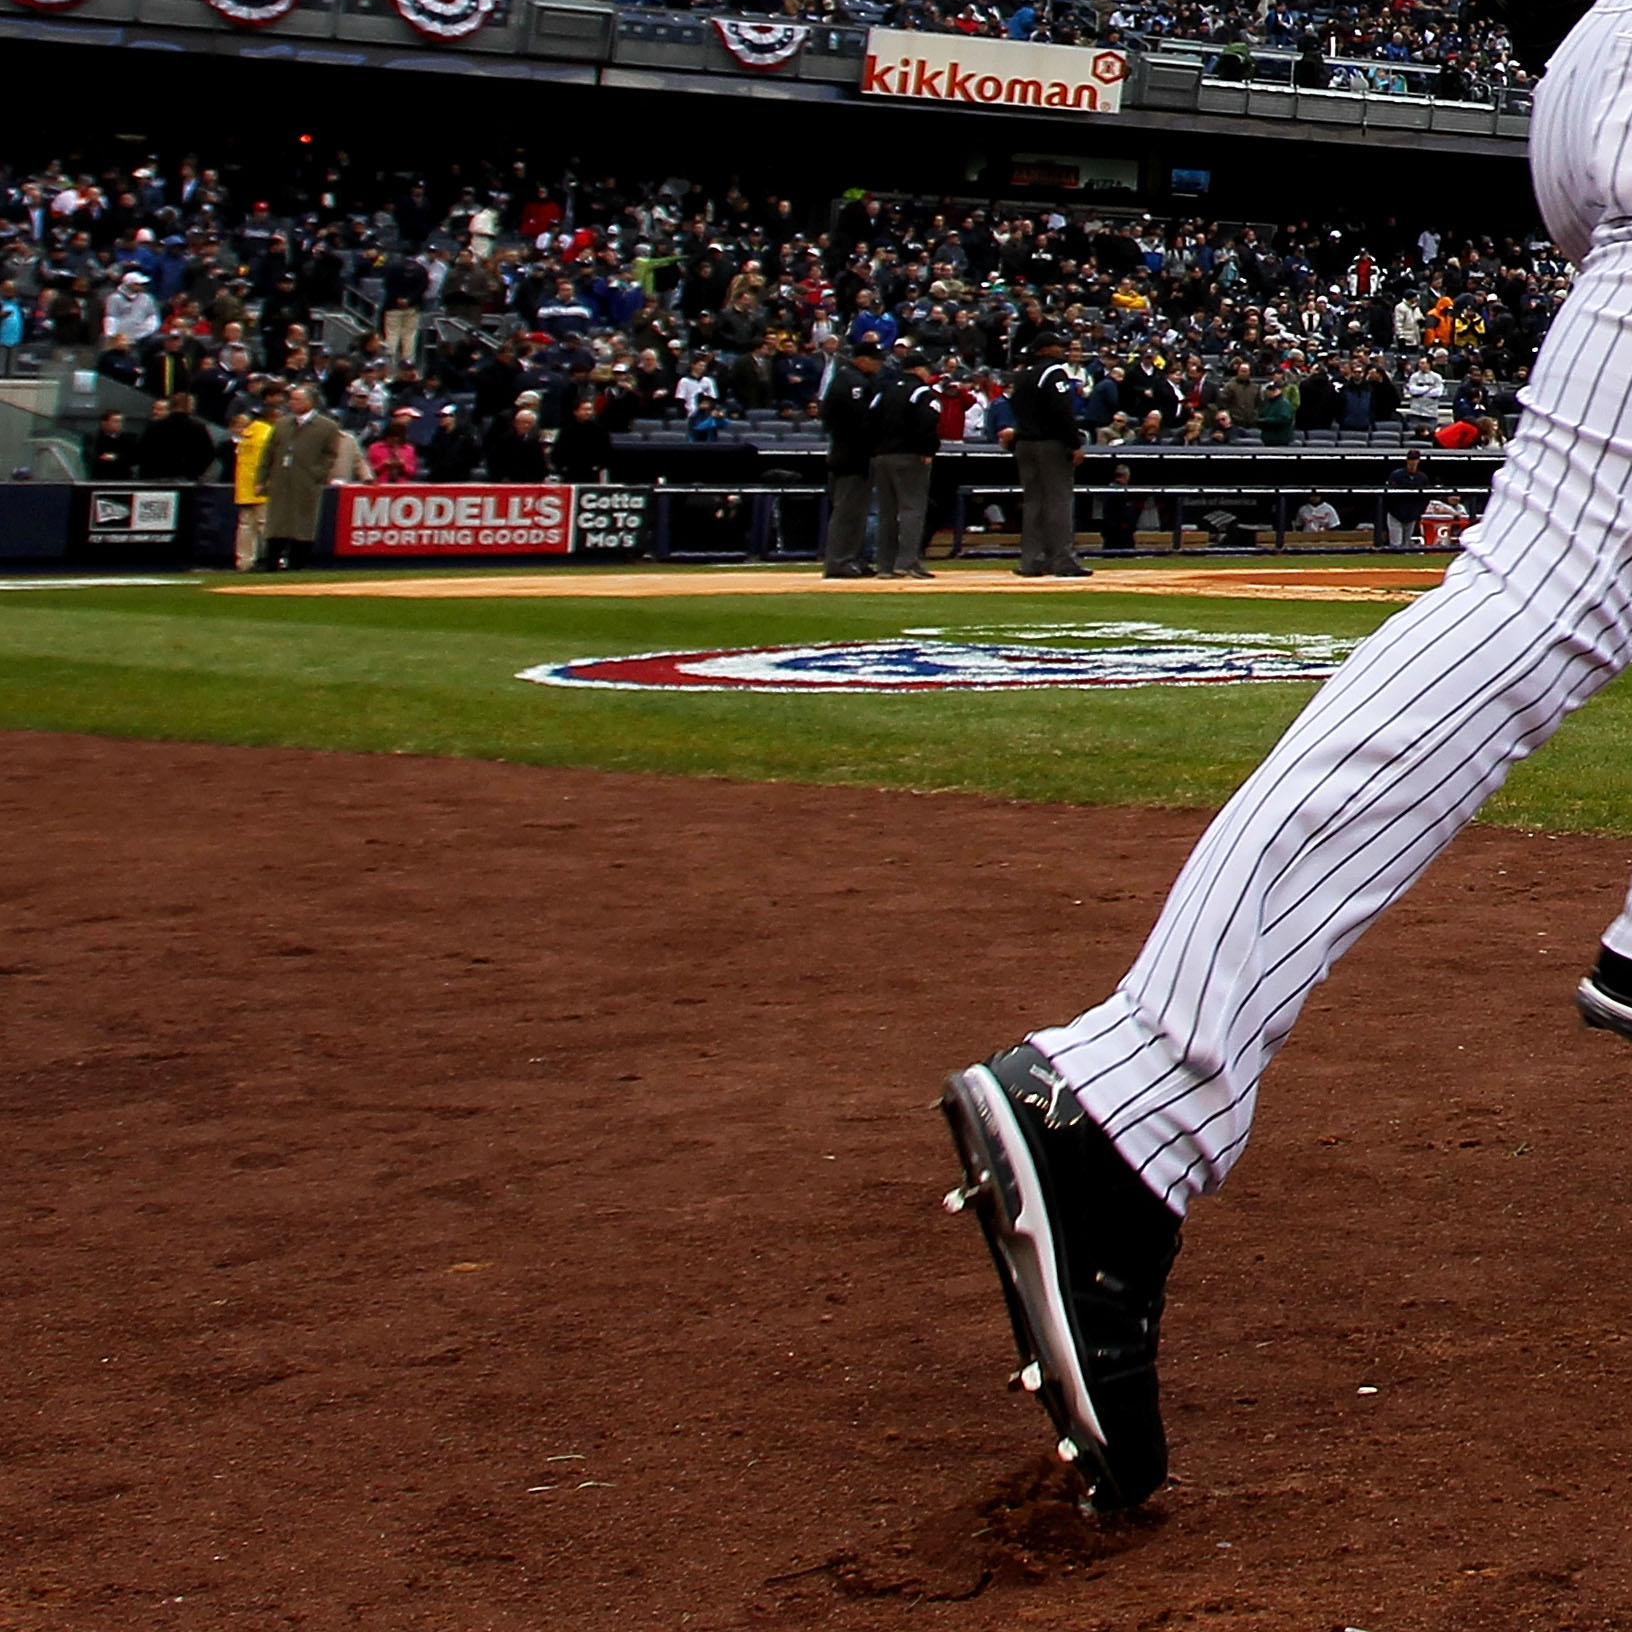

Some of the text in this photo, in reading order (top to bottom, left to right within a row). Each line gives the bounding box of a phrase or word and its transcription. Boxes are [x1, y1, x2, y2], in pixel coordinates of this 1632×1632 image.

[861, 55, 1099, 112] kikkoman
[580, 493, 646, 509] Gotta
[351, 495, 563, 527] MODELL'S
[577, 512, 641, 529] Go To
[351, 529, 562, 546] SPORTING GOODS
[585, 532, 637, 547] Mo's
